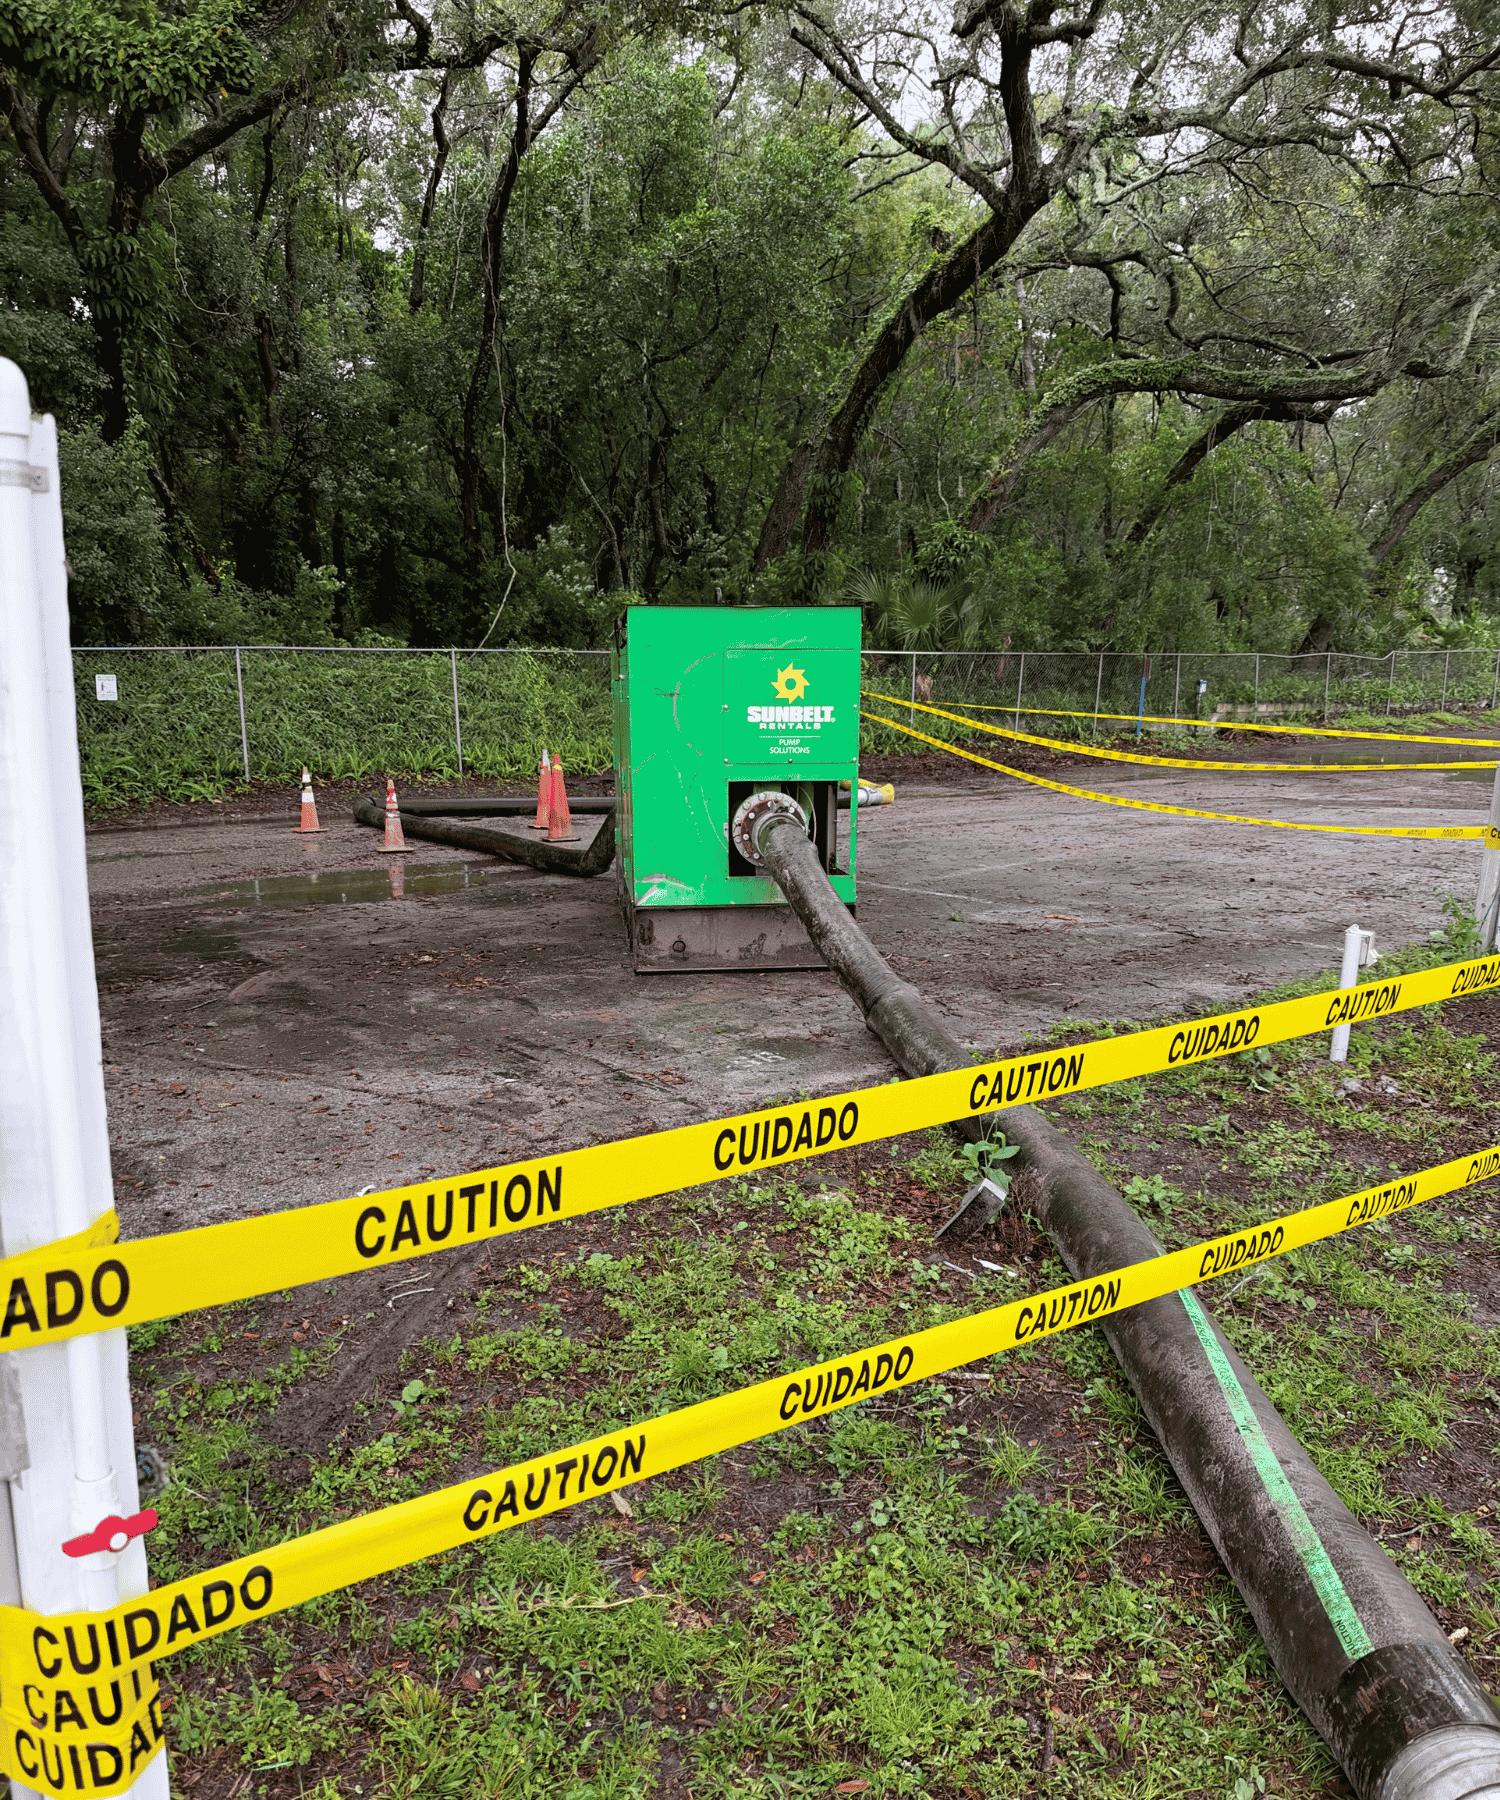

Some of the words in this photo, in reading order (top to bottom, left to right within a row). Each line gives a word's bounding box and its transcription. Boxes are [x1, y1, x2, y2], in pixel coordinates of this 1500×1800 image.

[747, 705, 835, 723] SUNBELT
[759, 722, 822, 730] RENTALS
[778, 738, 801, 746] PUMP
[769, 746, 811, 754] SOLUTIONS
[354, 1166, 562, 1258] CAUTION
[713, 1101, 859, 1171] CUIDADO
[969, 1053, 1085, 1110] CAUTION
[1168, 1015, 1260, 1064] CUIDADO
[1325, 984, 1402, 1026] CAUTION
[32, 1564, 273, 1680] CUIDADO
[463, 1434, 646, 1532] CAUTION
[779, 1345, 914, 1421] CUIDADO
[1014, 1278, 1122, 1341] CAUTION
[1198, 1225, 1284, 1278] CUIDADO
[1346, 1180, 1418, 1227] CAUTION
[1465, 1152, 1500, 1184] CUID
